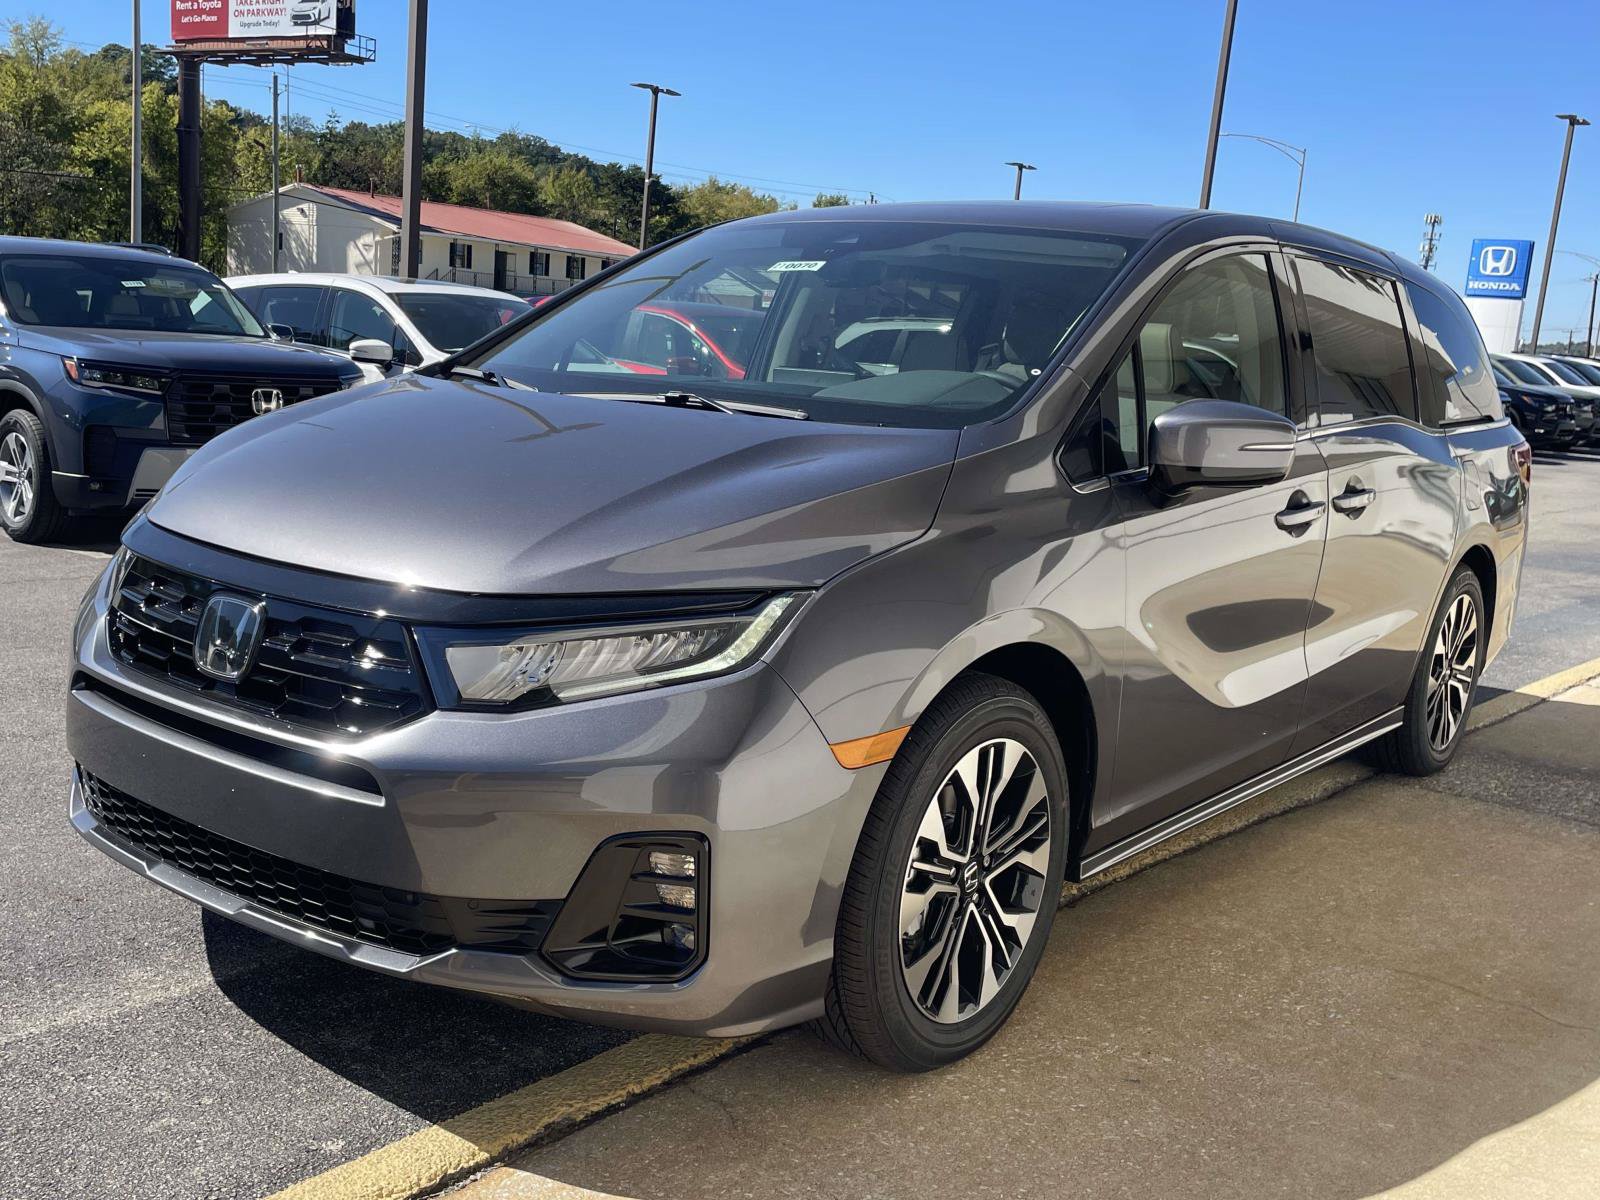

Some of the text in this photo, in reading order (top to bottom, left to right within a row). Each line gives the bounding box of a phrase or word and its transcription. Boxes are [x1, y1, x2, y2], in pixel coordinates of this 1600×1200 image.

[176, 1, 192, 10] Rent
[199, 0, 221, 10] Toyota
[234, 8, 286, 17] ON PARKWAY!
[181, 15, 192, 23] Let's
[202, 14, 218, 22] Places
[240, 19, 280, 28] Upgrade Today!
[1468, 281, 1521, 290] HONDA
